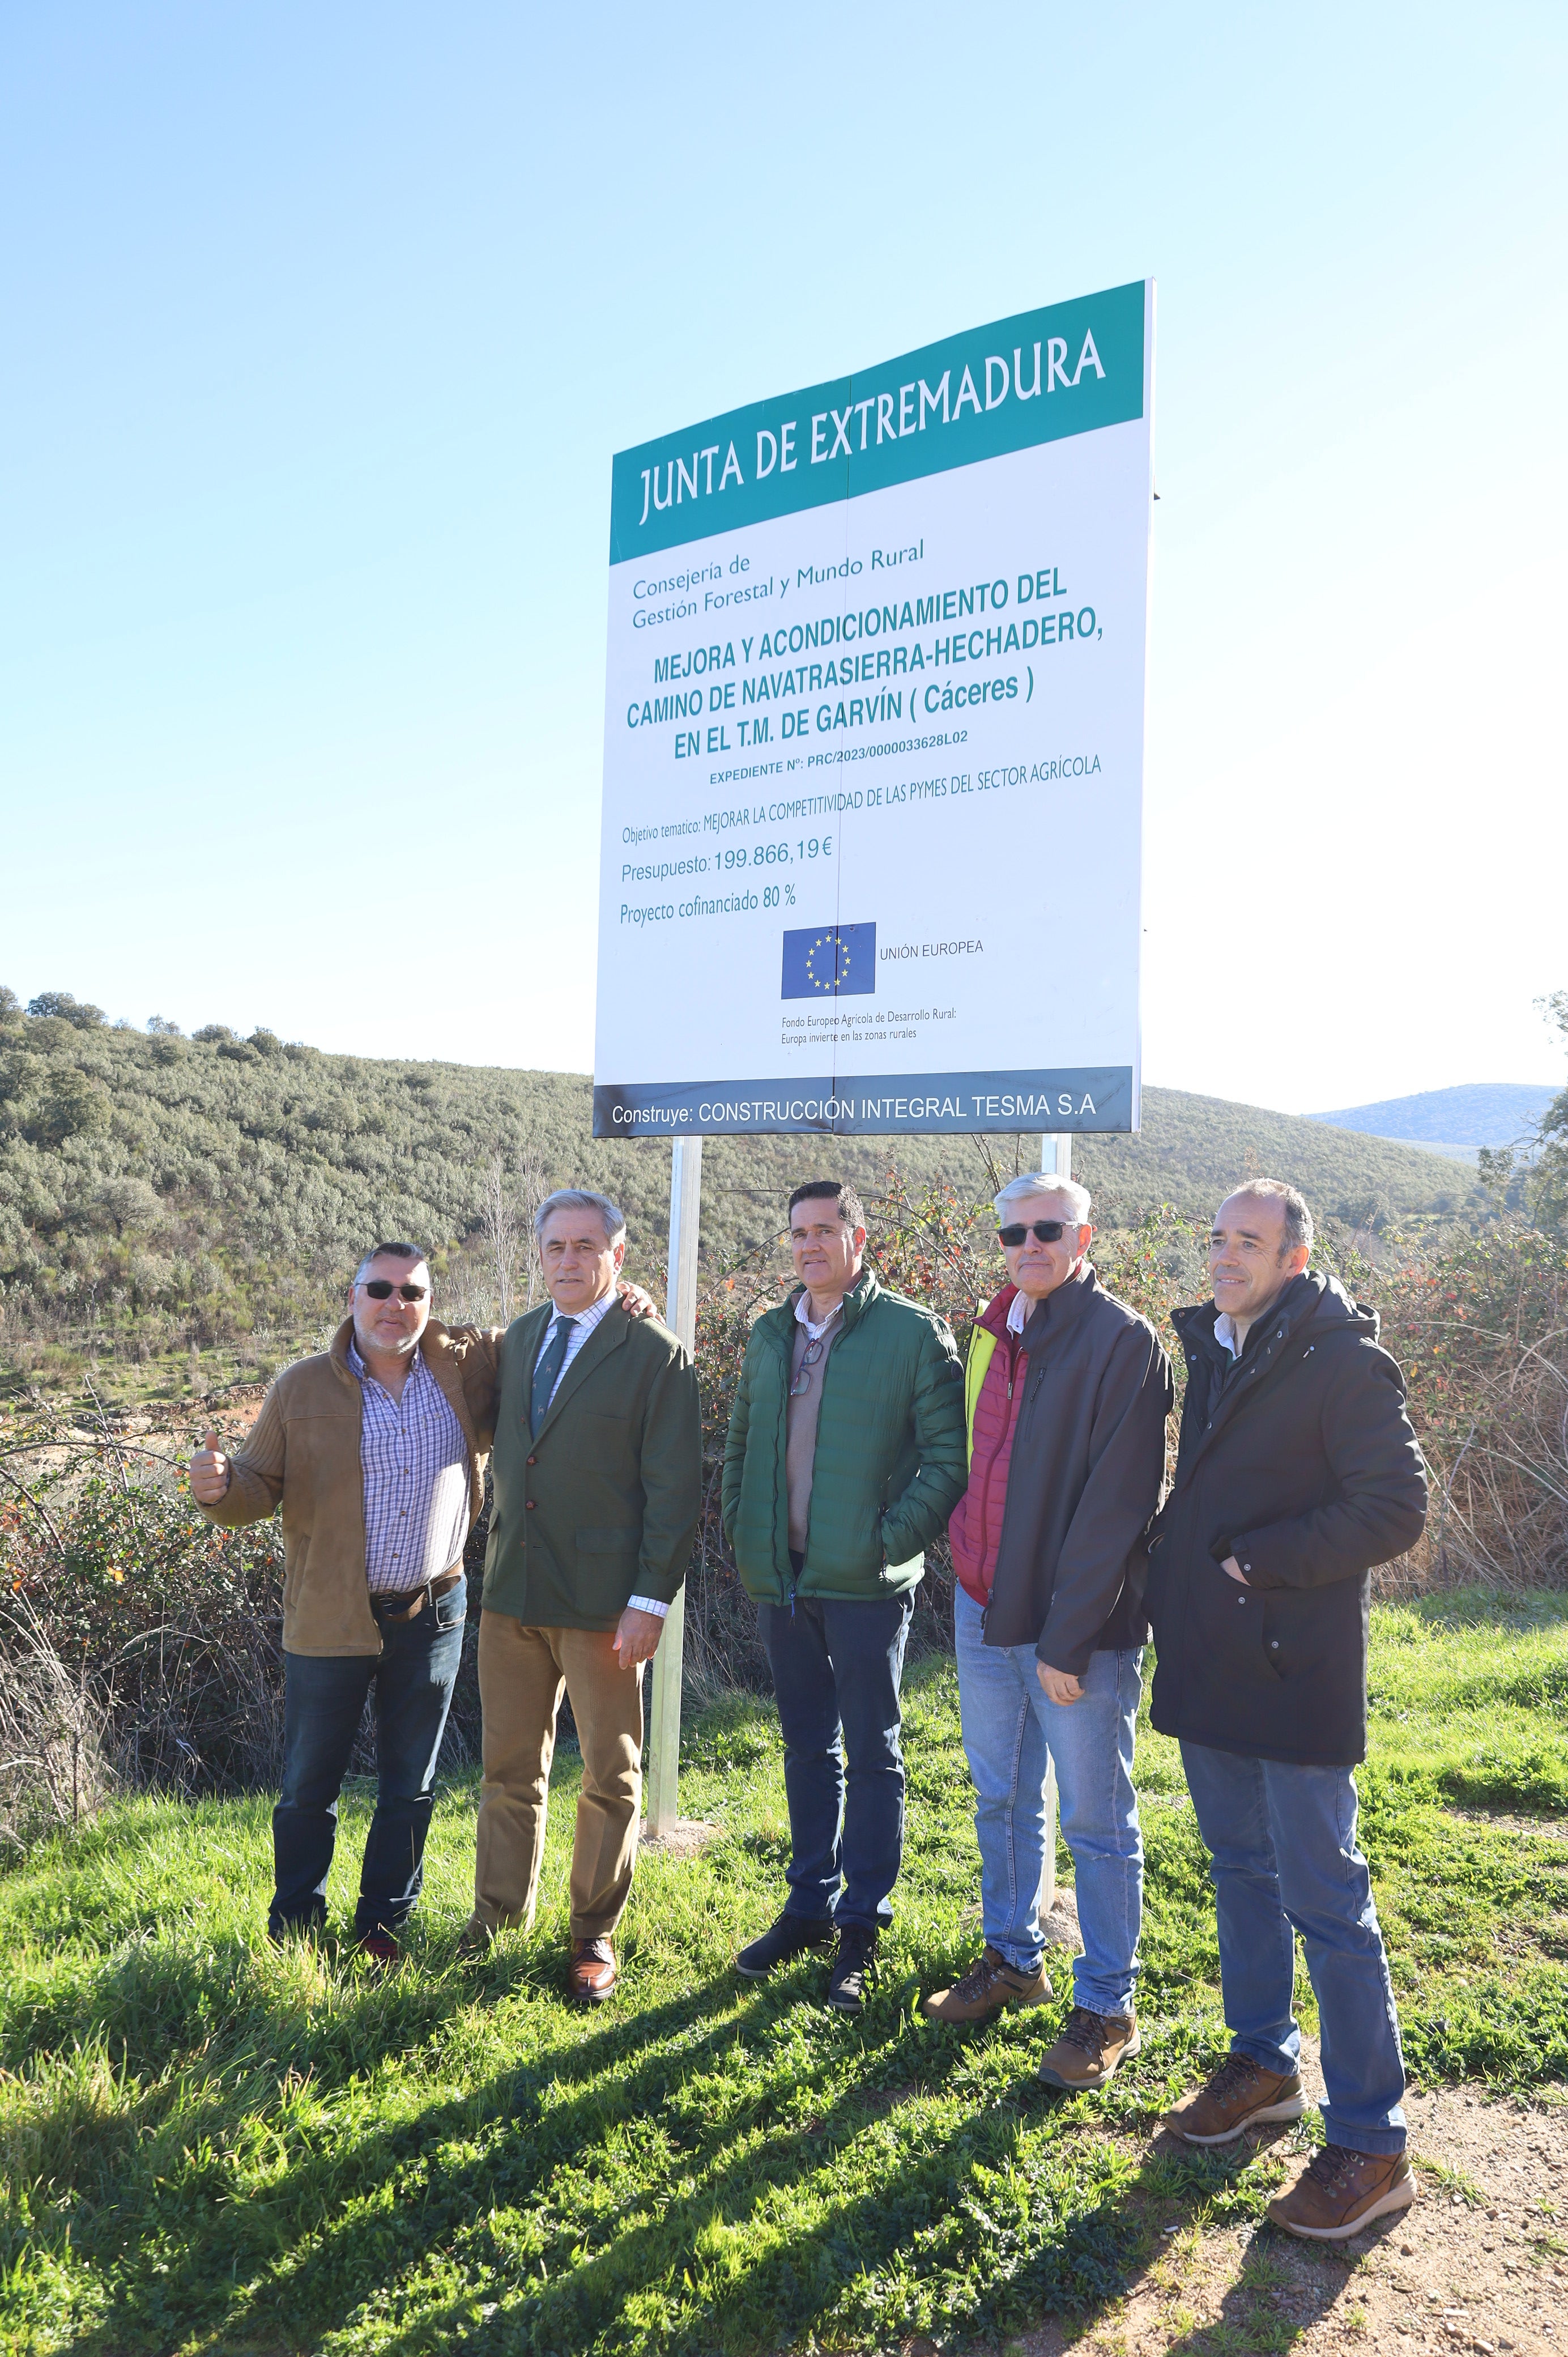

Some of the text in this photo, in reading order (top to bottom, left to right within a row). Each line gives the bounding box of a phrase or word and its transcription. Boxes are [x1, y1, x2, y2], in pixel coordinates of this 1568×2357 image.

[639, 327, 1106, 525] JUNTA DE EXTREMADURA
[633, 554, 750, 599] Consejería de
[633, 539, 924, 628] Gestión Forestal y Mundo Rural
[654, 567, 1067, 683] MEJORA Y ACONDICIONAMIENTO DEL
[627, 689, 703, 728] CAMINO
[710, 683, 735, 712] DE
[675, 730, 700, 759] EN
[707, 726, 731, 753] EL
[737, 717, 774, 747] T.M.
[782, 709, 809, 739] DE
[816, 686, 902, 732] GARVÍN
[924, 677, 1018, 713] Cáceres
[710, 762, 783, 784] EXPEDIENTE
[808, 730, 968, 767] PRC/2023/0000033628L02
[623, 754, 1101, 846] Objetivo tematico: MEJORAR LA COMPETITIVIDAD DE LAS PYMES DEL SECTOR AGRÍCOLA
[623, 856, 710, 882] Presupuesto:
[621, 883, 795, 928] Proyecto cofinanciado 80 %
[880, 940, 983, 960] UNIÓN EUROPEA
[782, 1007, 956, 1029] Fondo Europeo Agrícola de Desarrollo Rural:
[782, 1033, 807, 1046] Europa
[809, 1031, 838, 1043] invierte
[853, 1030, 862, 1041] las
[864, 1031, 887, 1040] zonas
[889, 1027, 916, 1038] rurales
[612, 1093, 1096, 1126] Construye: CONSTRUCCIÓN INTEGRAL TESMA S.A
